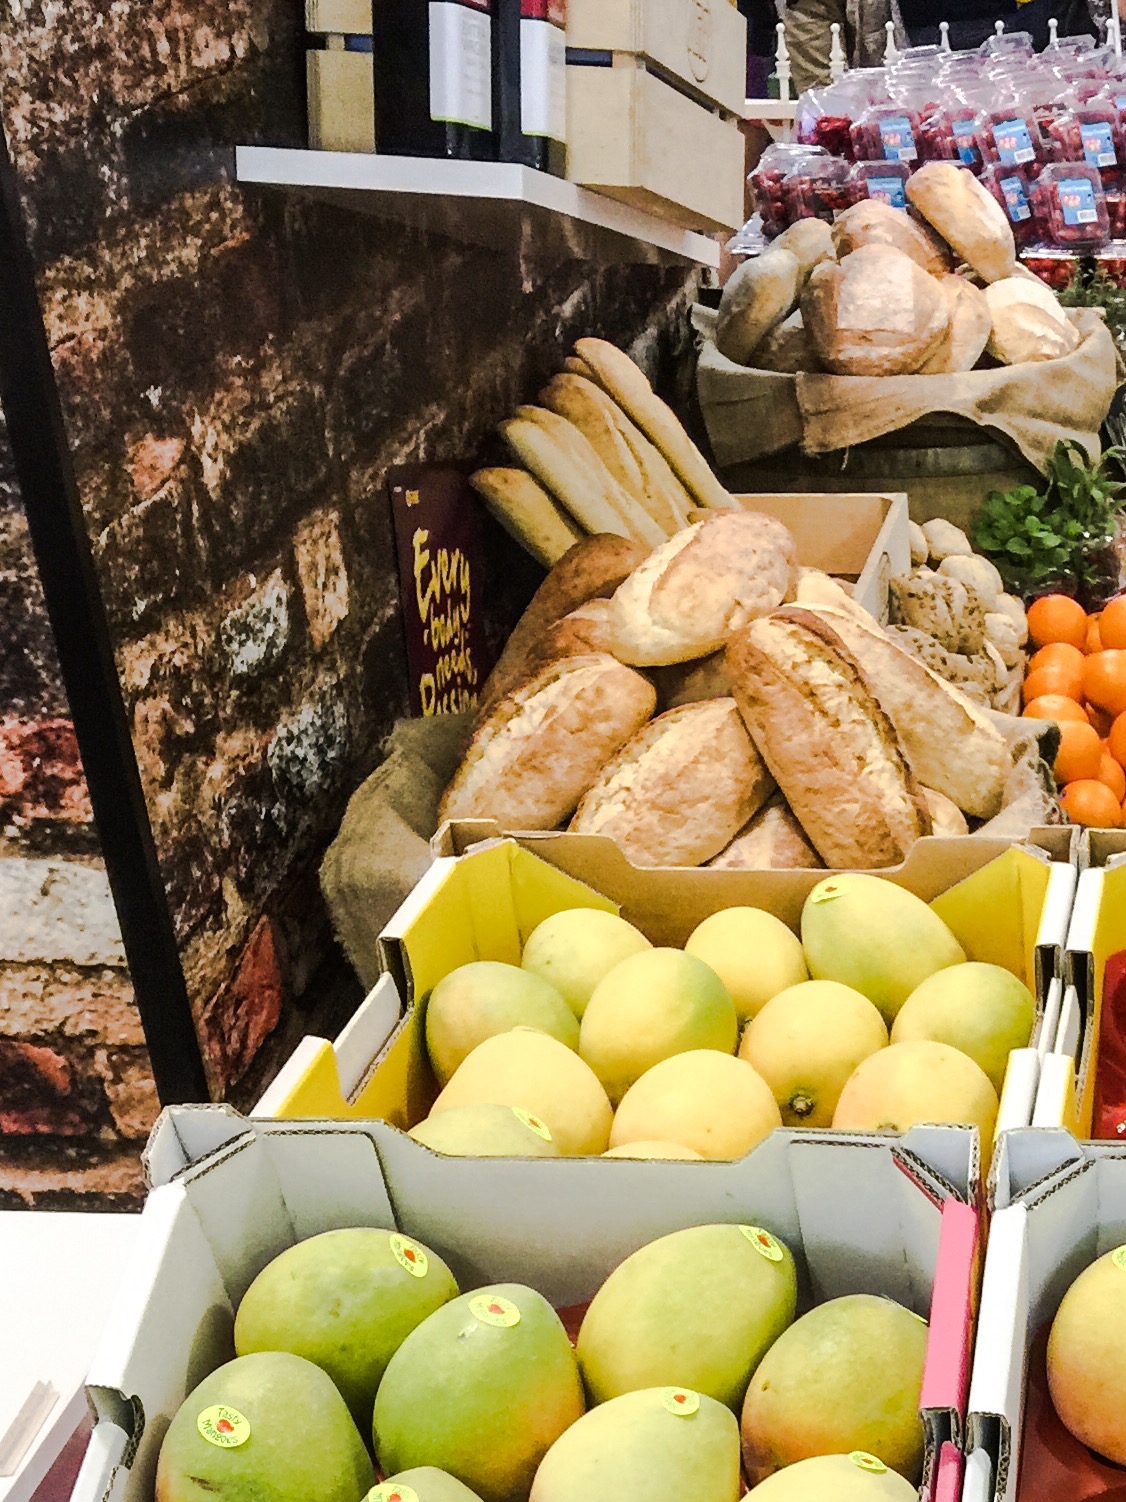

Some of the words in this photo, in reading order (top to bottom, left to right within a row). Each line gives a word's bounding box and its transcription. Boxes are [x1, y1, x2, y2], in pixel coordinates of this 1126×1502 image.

[412, 526, 471, 624] Every
[218, 1407, 242, 1425] Tasty
[202, 1419, 239, 1444] Mangoes
